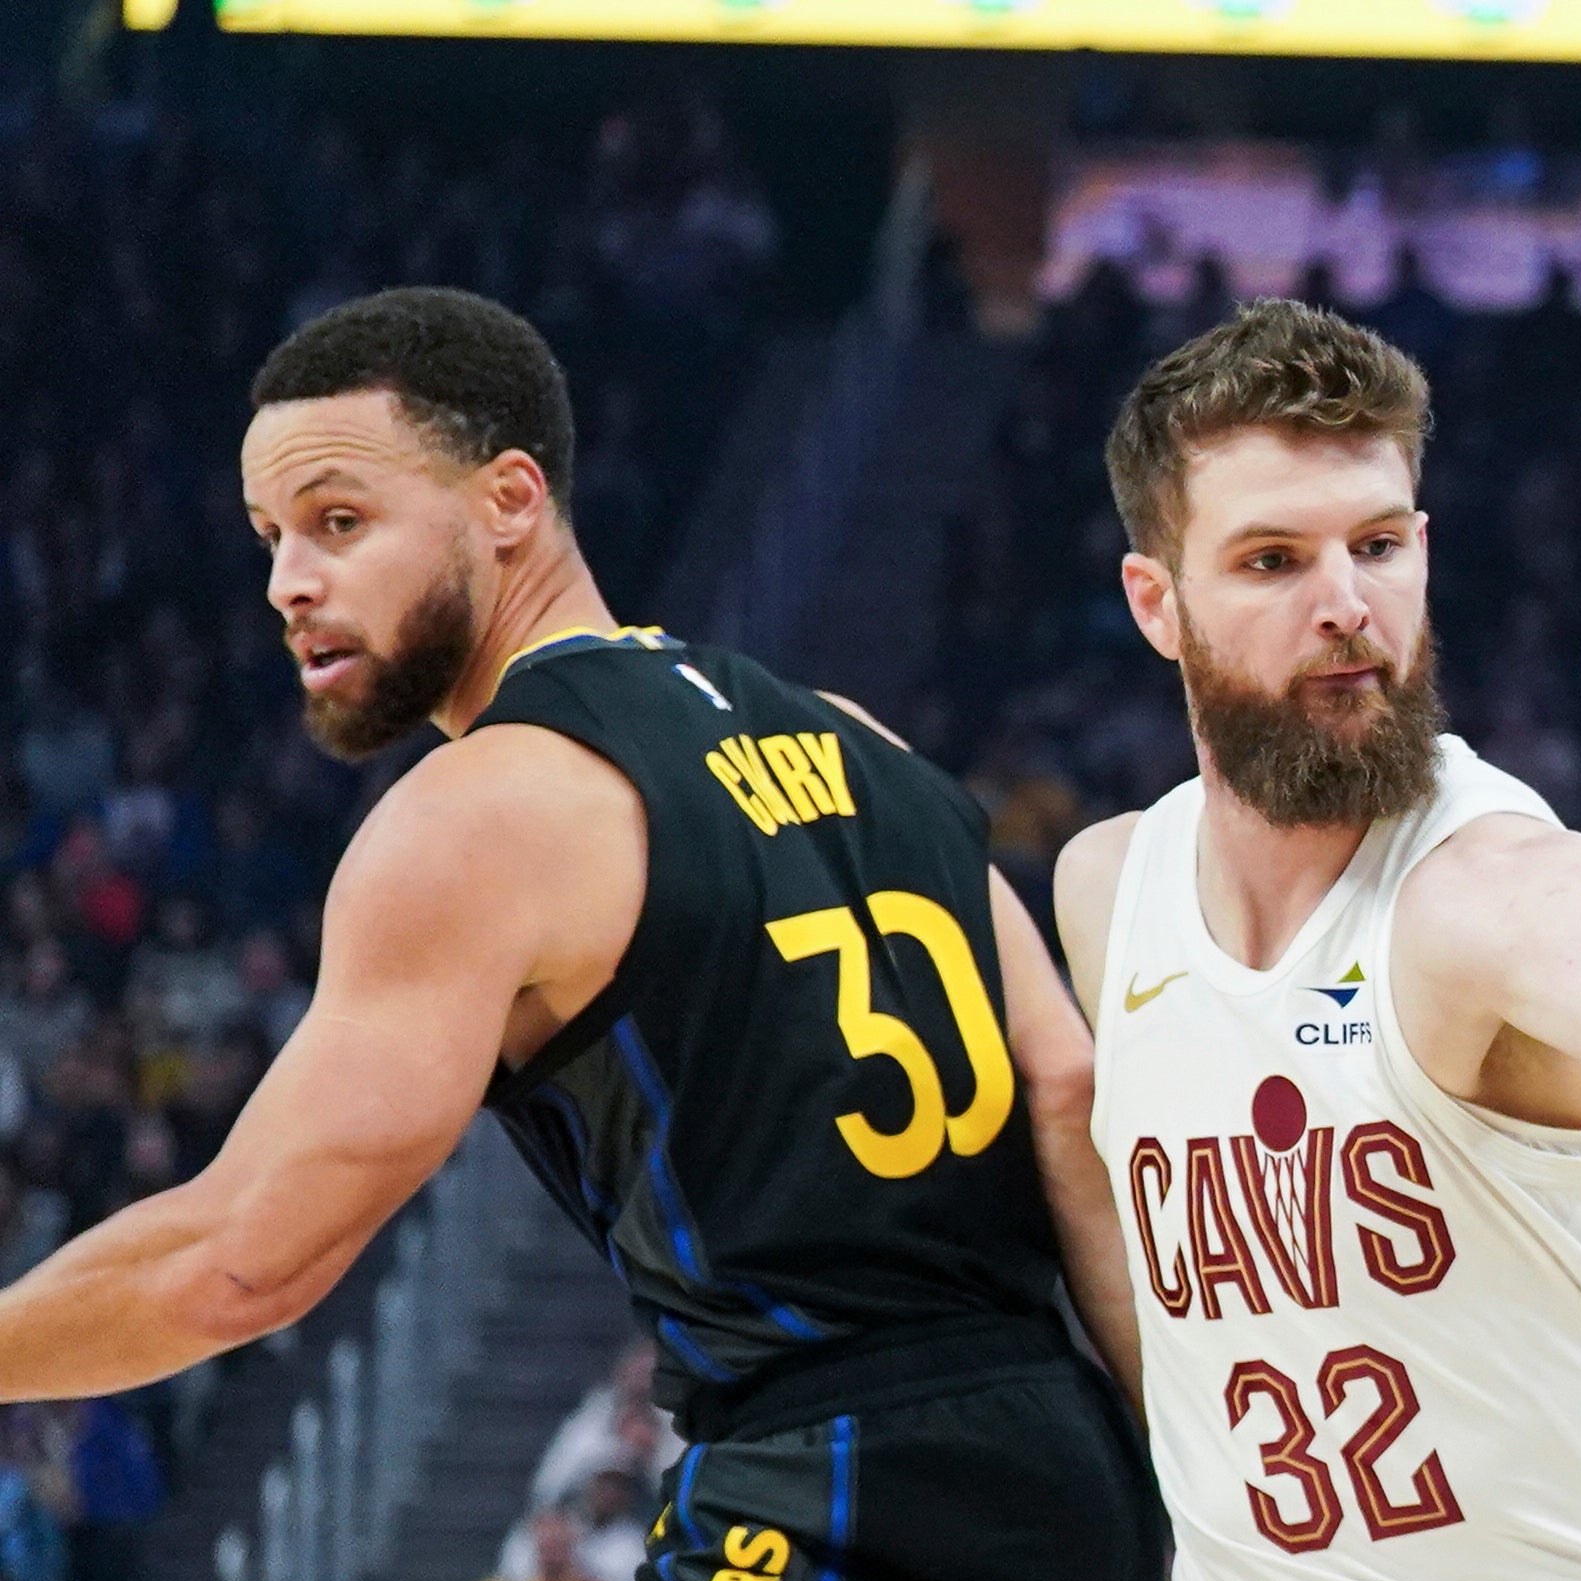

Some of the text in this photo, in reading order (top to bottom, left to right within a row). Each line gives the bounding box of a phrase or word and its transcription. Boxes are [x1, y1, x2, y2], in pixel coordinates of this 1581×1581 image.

[764, 890, 1015, 1179] 30
[1129, 1120, 1456, 1320] CAVS
[1224, 1344, 1465, 1555] 32
